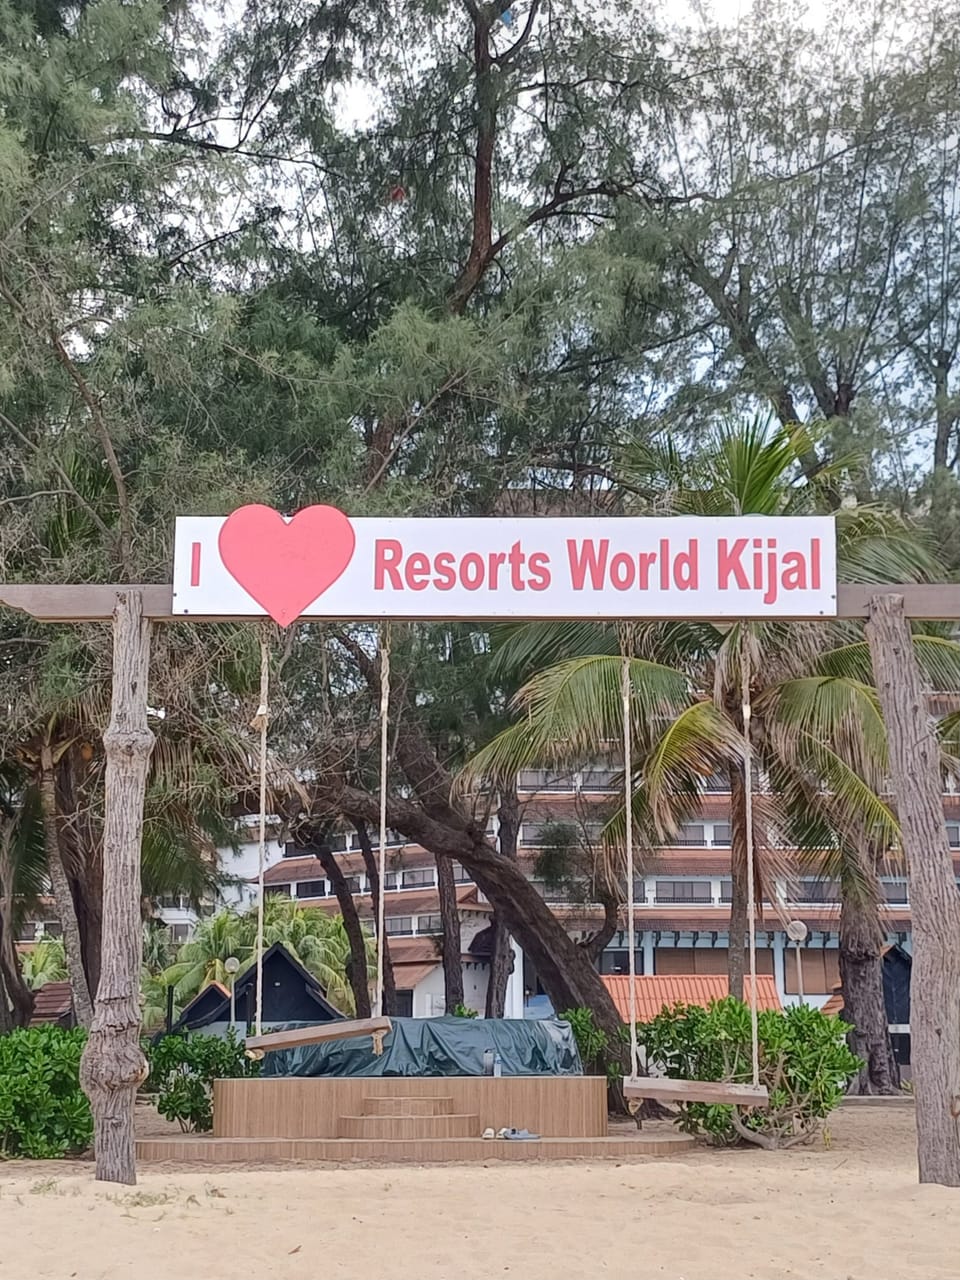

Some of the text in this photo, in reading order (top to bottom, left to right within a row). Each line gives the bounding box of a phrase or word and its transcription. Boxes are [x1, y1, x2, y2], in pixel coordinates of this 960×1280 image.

[190, 536, 821, 605] I Resorts World Kijal
